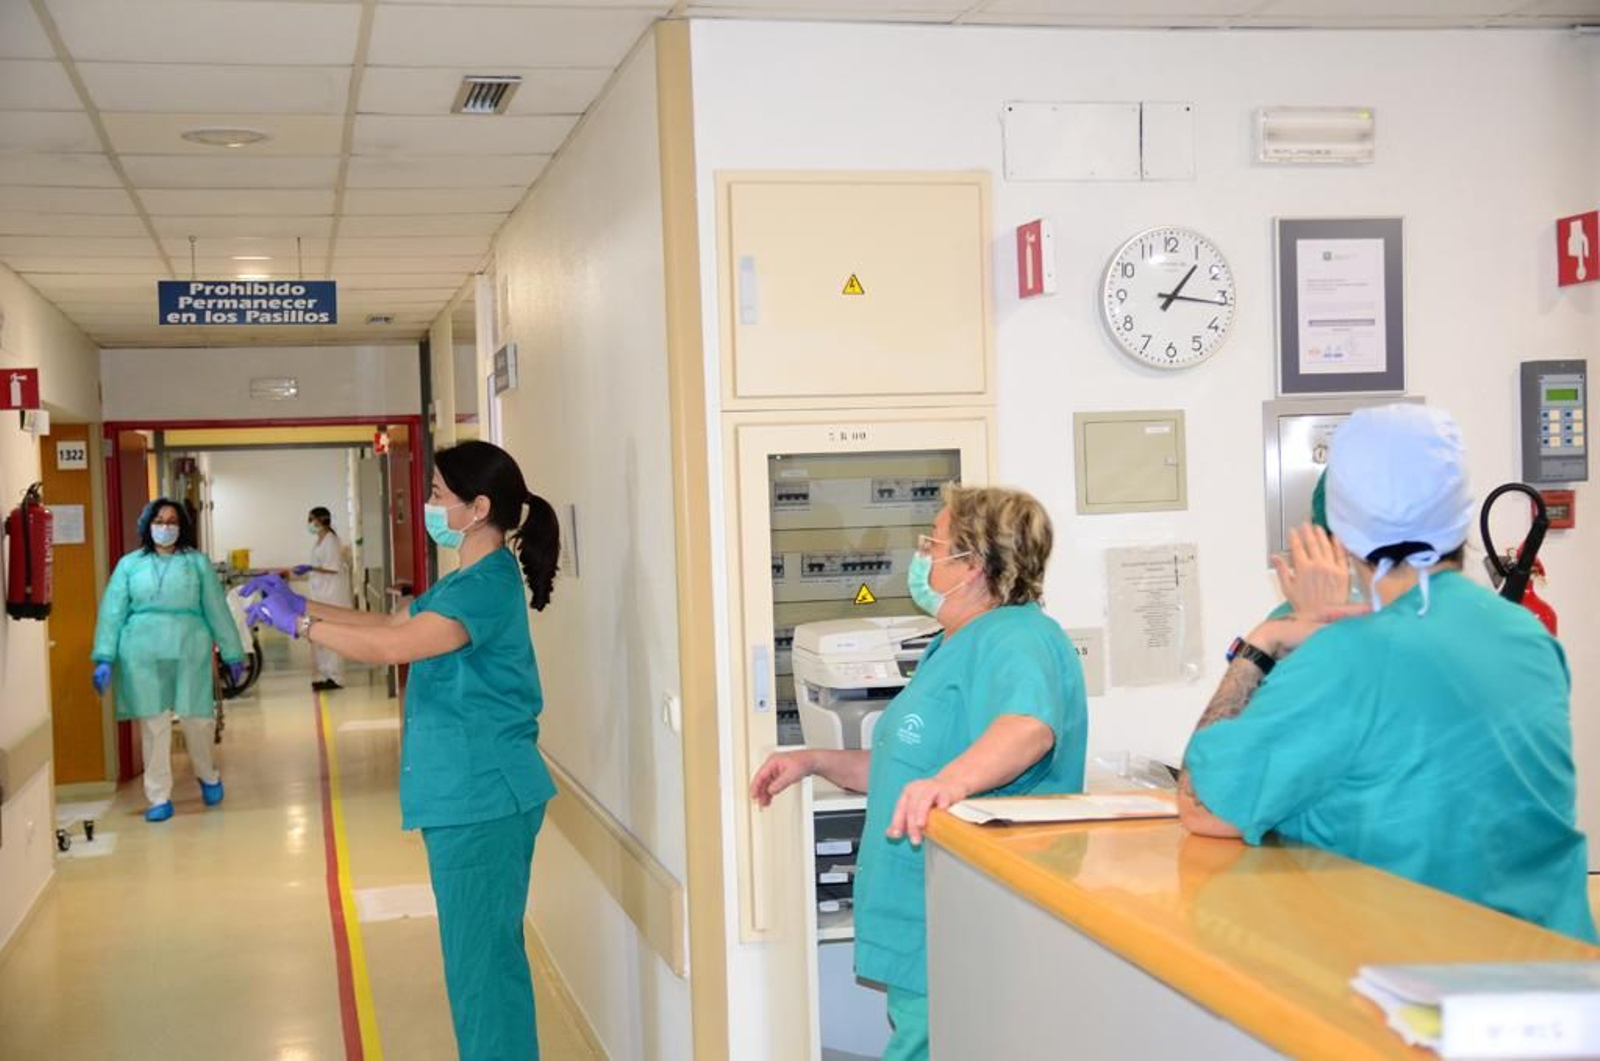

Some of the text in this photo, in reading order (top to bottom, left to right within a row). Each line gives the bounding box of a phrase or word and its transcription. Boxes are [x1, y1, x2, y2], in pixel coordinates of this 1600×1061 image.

[1141, 243, 1152, 261] 11
[1164, 236, 1179, 253] 12
[1121, 262, 1135, 279] 10
[1208, 264, 1221, 281] 2
[190, 282, 305, 296] Prohibido
[1116, 288, 1127, 304] 9
[178, 296, 317, 309] Permanecer
[1217, 290, 1228, 306] 3
[167, 310, 329, 323] en los Pasillos
[1122, 315, 1134, 332] 8
[1207, 316, 1219, 332] 4
[1141, 334, 1152, 350] 7
[1165, 342, 1177, 358] 6
[1191, 335, 1203, 352] 5
[60, 449, 84, 461] 1322
